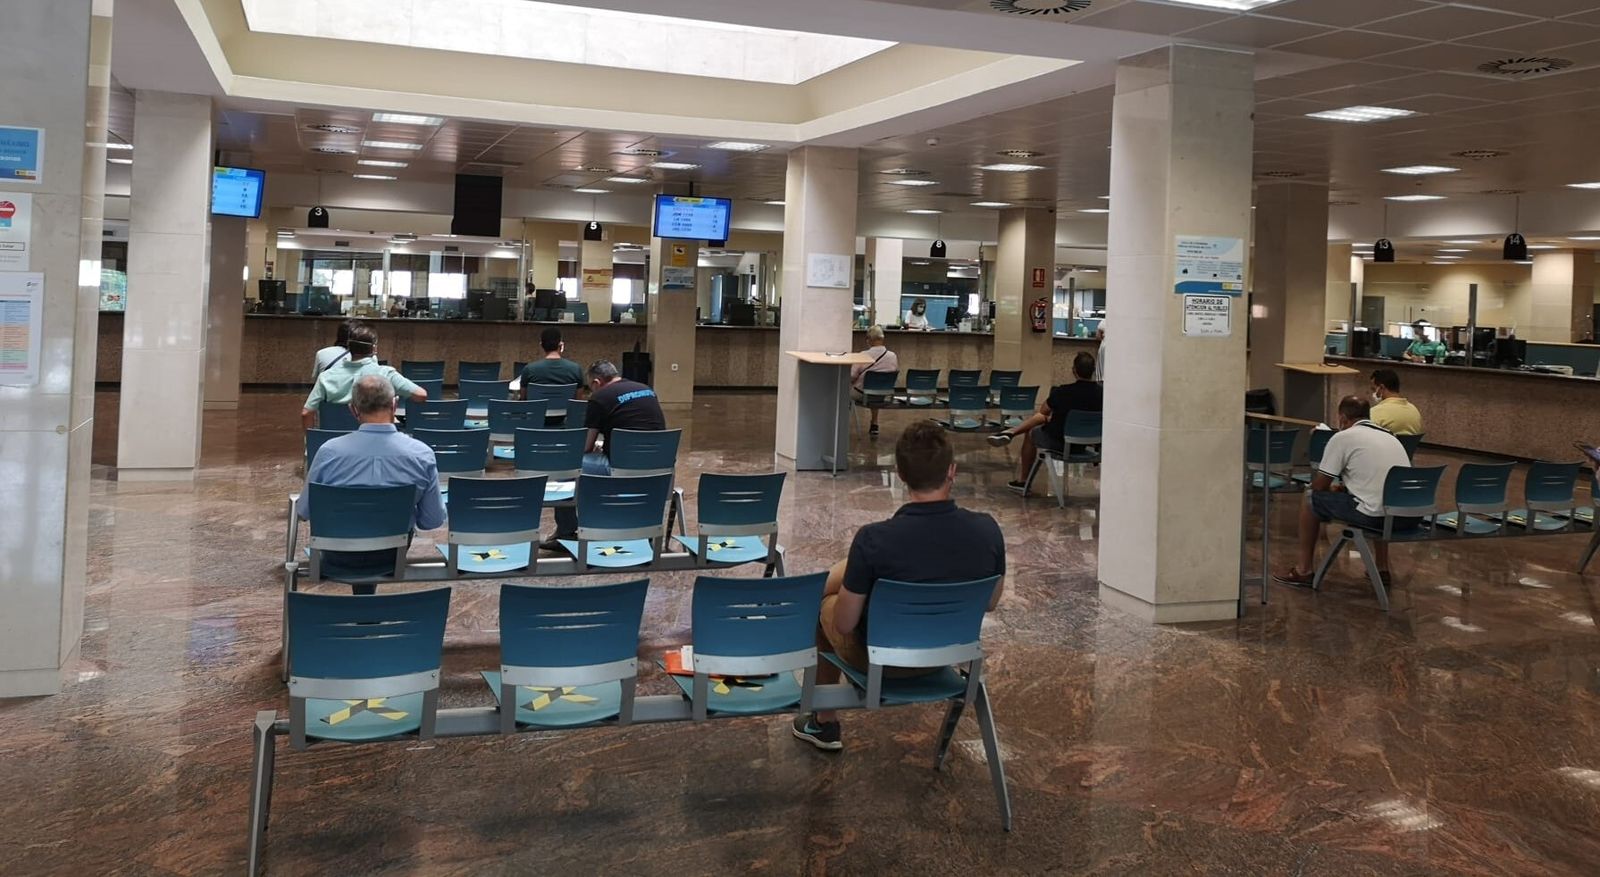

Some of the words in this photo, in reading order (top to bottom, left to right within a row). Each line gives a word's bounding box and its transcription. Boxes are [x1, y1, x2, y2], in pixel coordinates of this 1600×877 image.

[315, 207, 323, 216] 3
[590, 221, 597, 230] 5
[936, 240, 942, 248] 8
[1510, 234, 1520, 245] 14
[1379, 240, 1389, 249] 13
